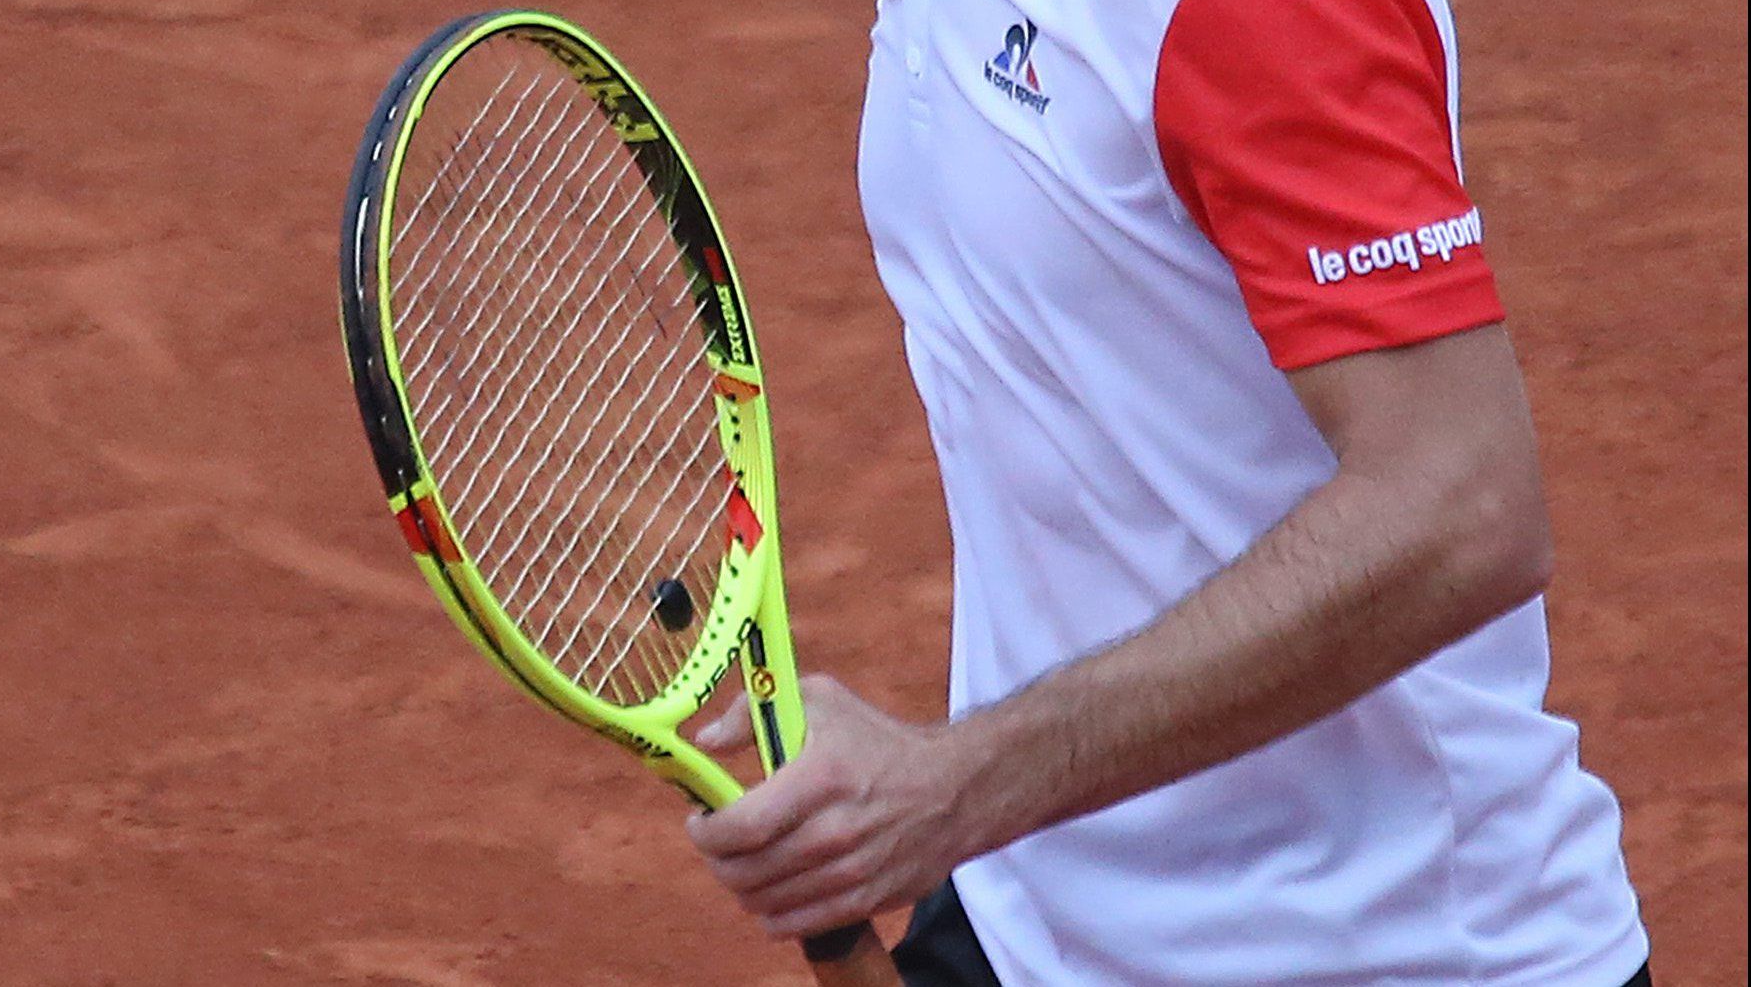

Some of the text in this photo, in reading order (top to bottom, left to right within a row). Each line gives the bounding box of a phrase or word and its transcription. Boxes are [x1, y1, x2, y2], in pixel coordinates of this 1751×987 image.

[993, 72, 1013, 100] coq
[1308, 246, 1347, 285] le
[1348, 232, 1421, 274] coq
